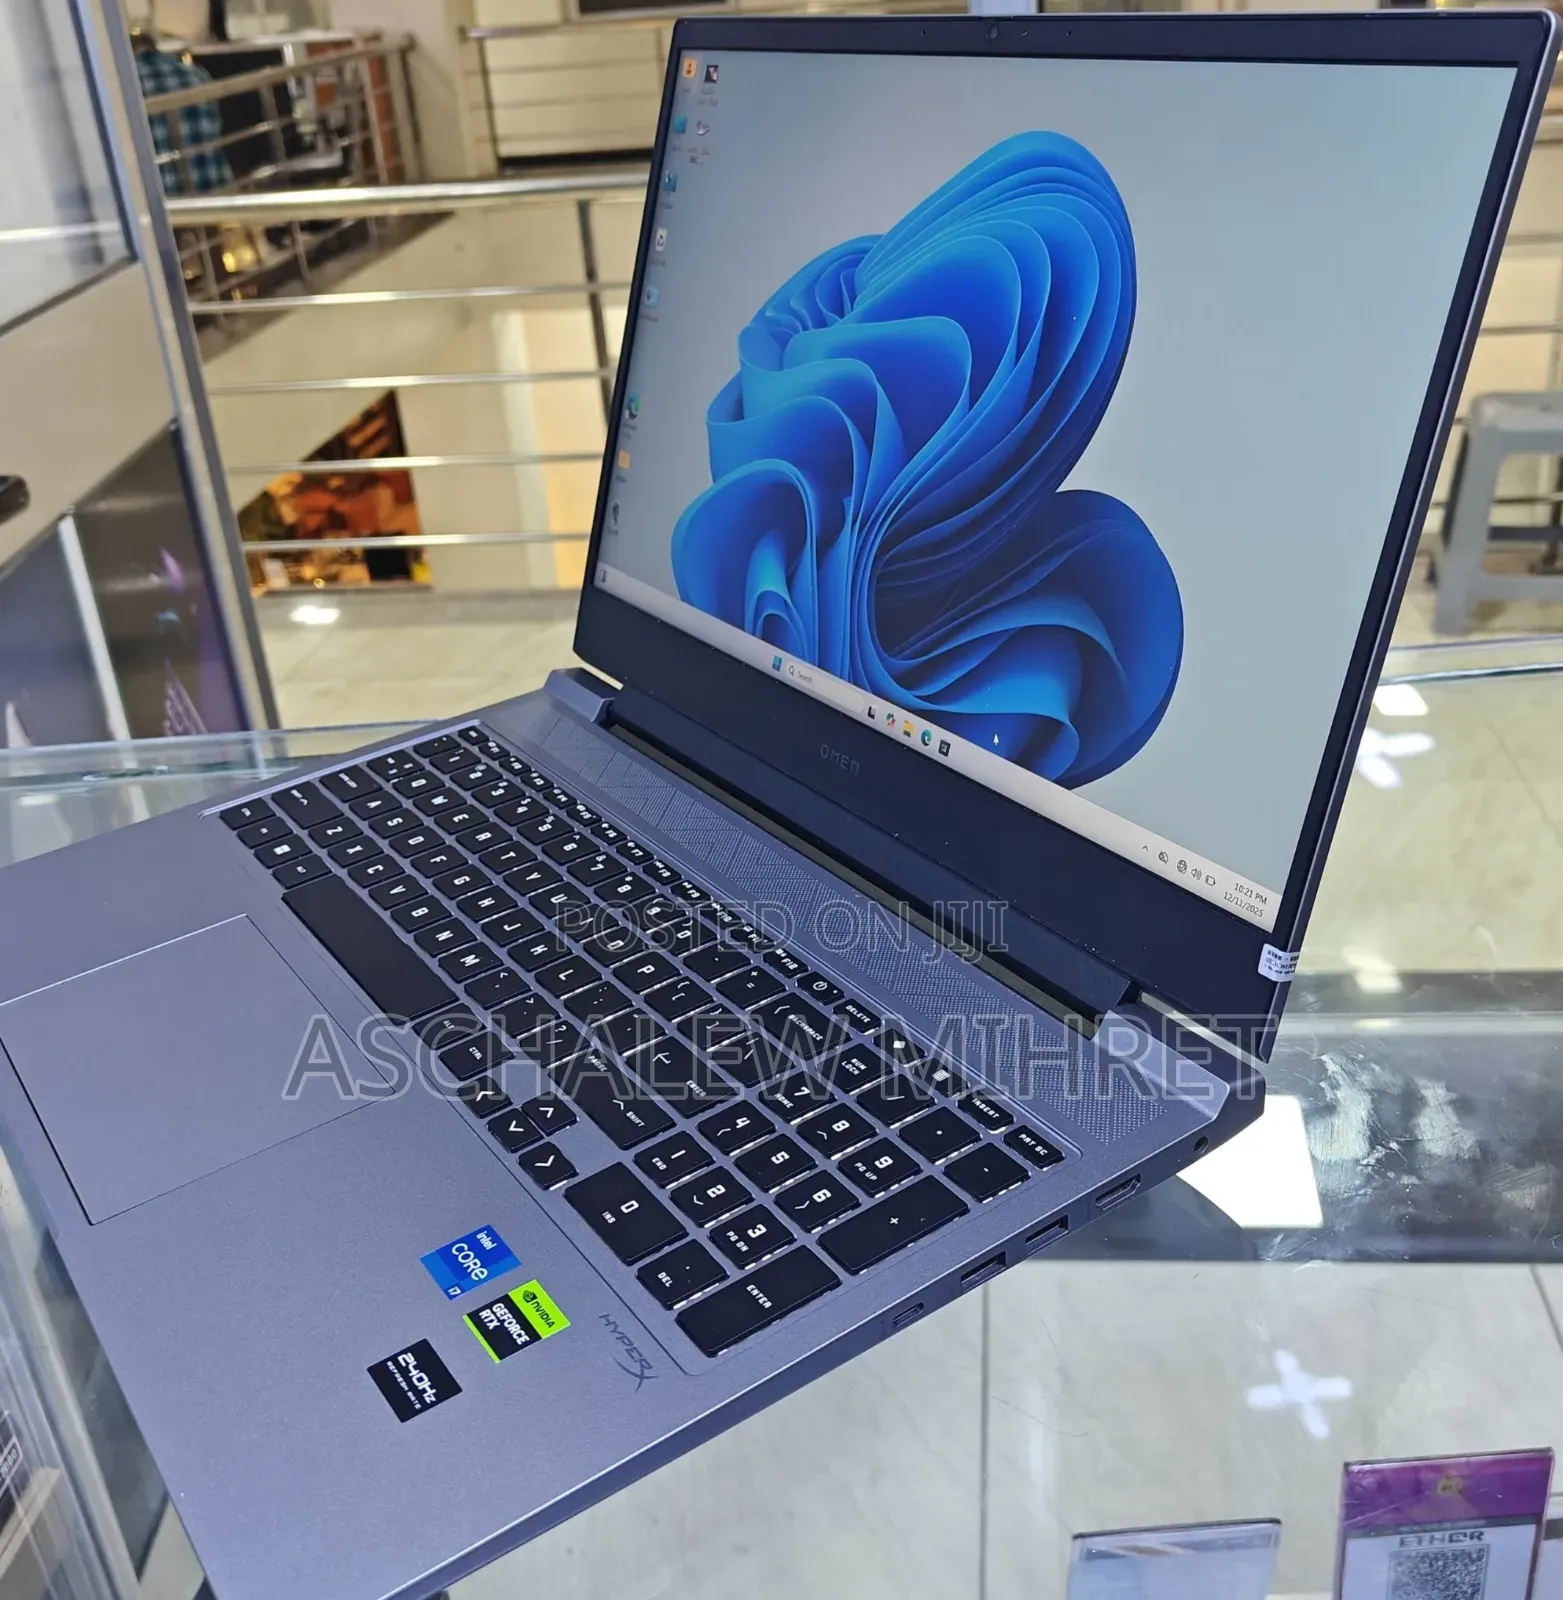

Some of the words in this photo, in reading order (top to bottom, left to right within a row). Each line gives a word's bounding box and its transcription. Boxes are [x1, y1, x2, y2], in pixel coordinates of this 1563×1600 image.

[797, 670, 813, 684] Search
[491, 788, 505, 796] 3
[367, 800, 382, 809] A
[431, 795, 449, 805] W
[386, 817, 403, 827] S
[452, 813, 470, 823] E
[326, 826, 343, 836] Z
[346, 845, 363, 855] X
[563, 842, 578, 852] 6
[430, 855, 448, 863] F
[500, 851, 517, 860] T
[366, 864, 384, 875] C
[590, 863, 605, 871] 7
[453, 875, 471, 885] G
[525, 871, 542, 881] Y
[389, 885, 406, 895] V
[617, 884, 632, 894] 8
[1234, 882, 1254, 899] 10:21
[1255, 893, 1268, 906] PM
[550, 894, 568, 904] U
[1223, 891, 1264, 918] 12/11/2025
[411, 907, 429, 918] B
[503, 923, 522, 932] J
[435, 930, 453, 941] N
[459, 954, 480, 967] M
[780, 957, 799, 970] F12
[558, 969, 574, 981] L
[637, 964, 655, 974] P
[845, 1004, 871, 1023] DELETE
[468, 1046, 483, 1060] CTRL
[841, 1060, 861, 1076] LOCK
[850, 1057, 868, 1071] NUM
[685, 1079, 707, 1098] ENTER
[793, 1086, 811, 1096] 7
[773, 1092, 794, 1109] HOME
[970, 1096, 1001, 1121] INSERT
[625, 1111, 646, 1128] SHIFT
[735, 1117, 751, 1130] 4
[831, 1119, 850, 1132] 8
[1018, 1131, 1037, 1148] PRT
[1034, 1145, 1048, 1156] SC
[651, 1157, 667, 1171] END
[770, 1150, 790, 1165] 5
[874, 1155, 894, 1169] 9
[854, 1162, 867, 1172] PG
[864, 1171, 878, 1181] UP
[706, 1184, 726, 1198] 2
[812, 1188, 832, 1203] 6
[620, 1200, 640, 1214] 0
[602, 1211, 616, 1224] INS
[747, 1224, 767, 1239] 3
[476, 1230, 497, 1250] intel
[725, 1230, 740, 1244] PG
[734, 1238, 749, 1252] DN
[657, 1271, 673, 1288] DEL
[746, 1284, 772, 1309] ENTER
[478, 1309, 500, 1330] RTX
[491, 1302, 530, 1345] GEFORCE
[386, 1361, 409, 1391] REFRESH
[406, 1391, 422, 1410] RATE
